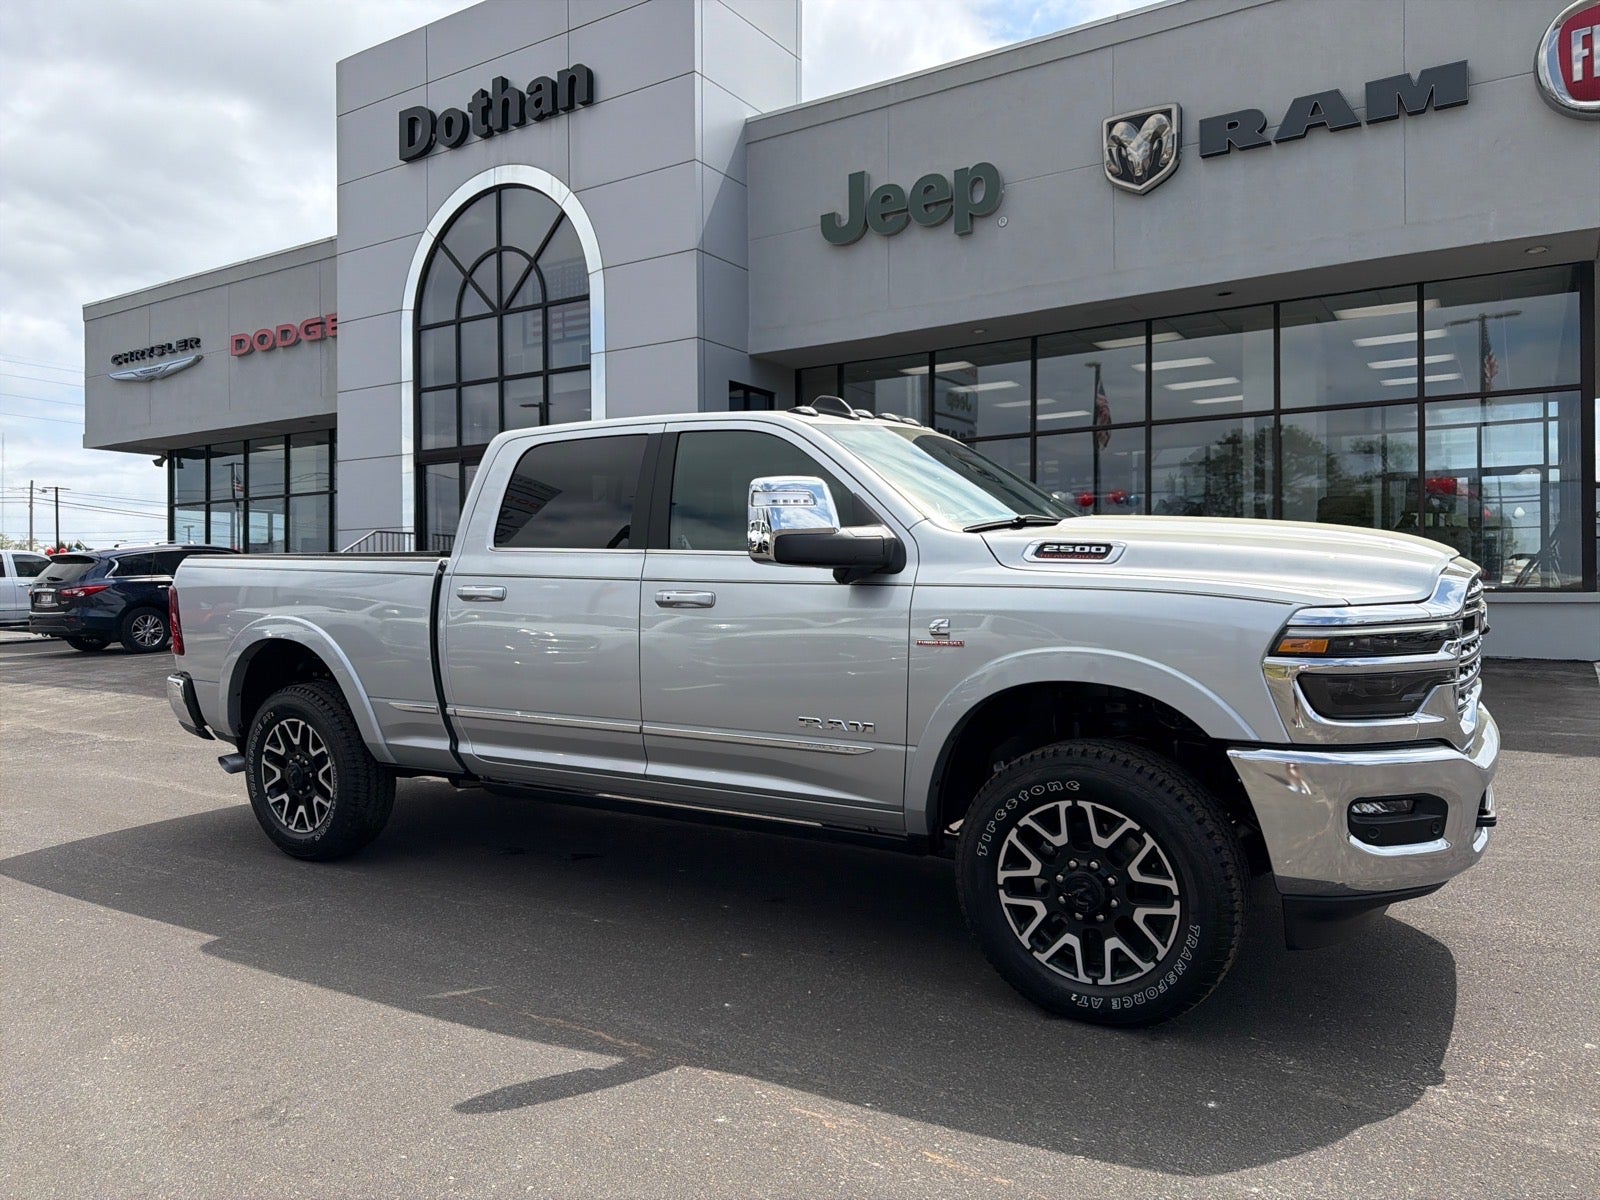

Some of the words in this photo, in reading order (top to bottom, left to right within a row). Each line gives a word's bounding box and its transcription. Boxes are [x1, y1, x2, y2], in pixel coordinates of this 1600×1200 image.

[399, 63, 594, 162] Dothan
[1199, 59, 1469, 159] RAM
[820, 162, 1003, 246] Jeep
[111, 337, 202, 366] CHRYSLER
[231, 313, 337, 356] DODGE
[1043, 545, 1106, 553] 2500
[798, 716, 875, 733] RAM
[976, 780, 1080, 857] Firestone
[1111, 924, 1200, 1010] TRANSFORCE
